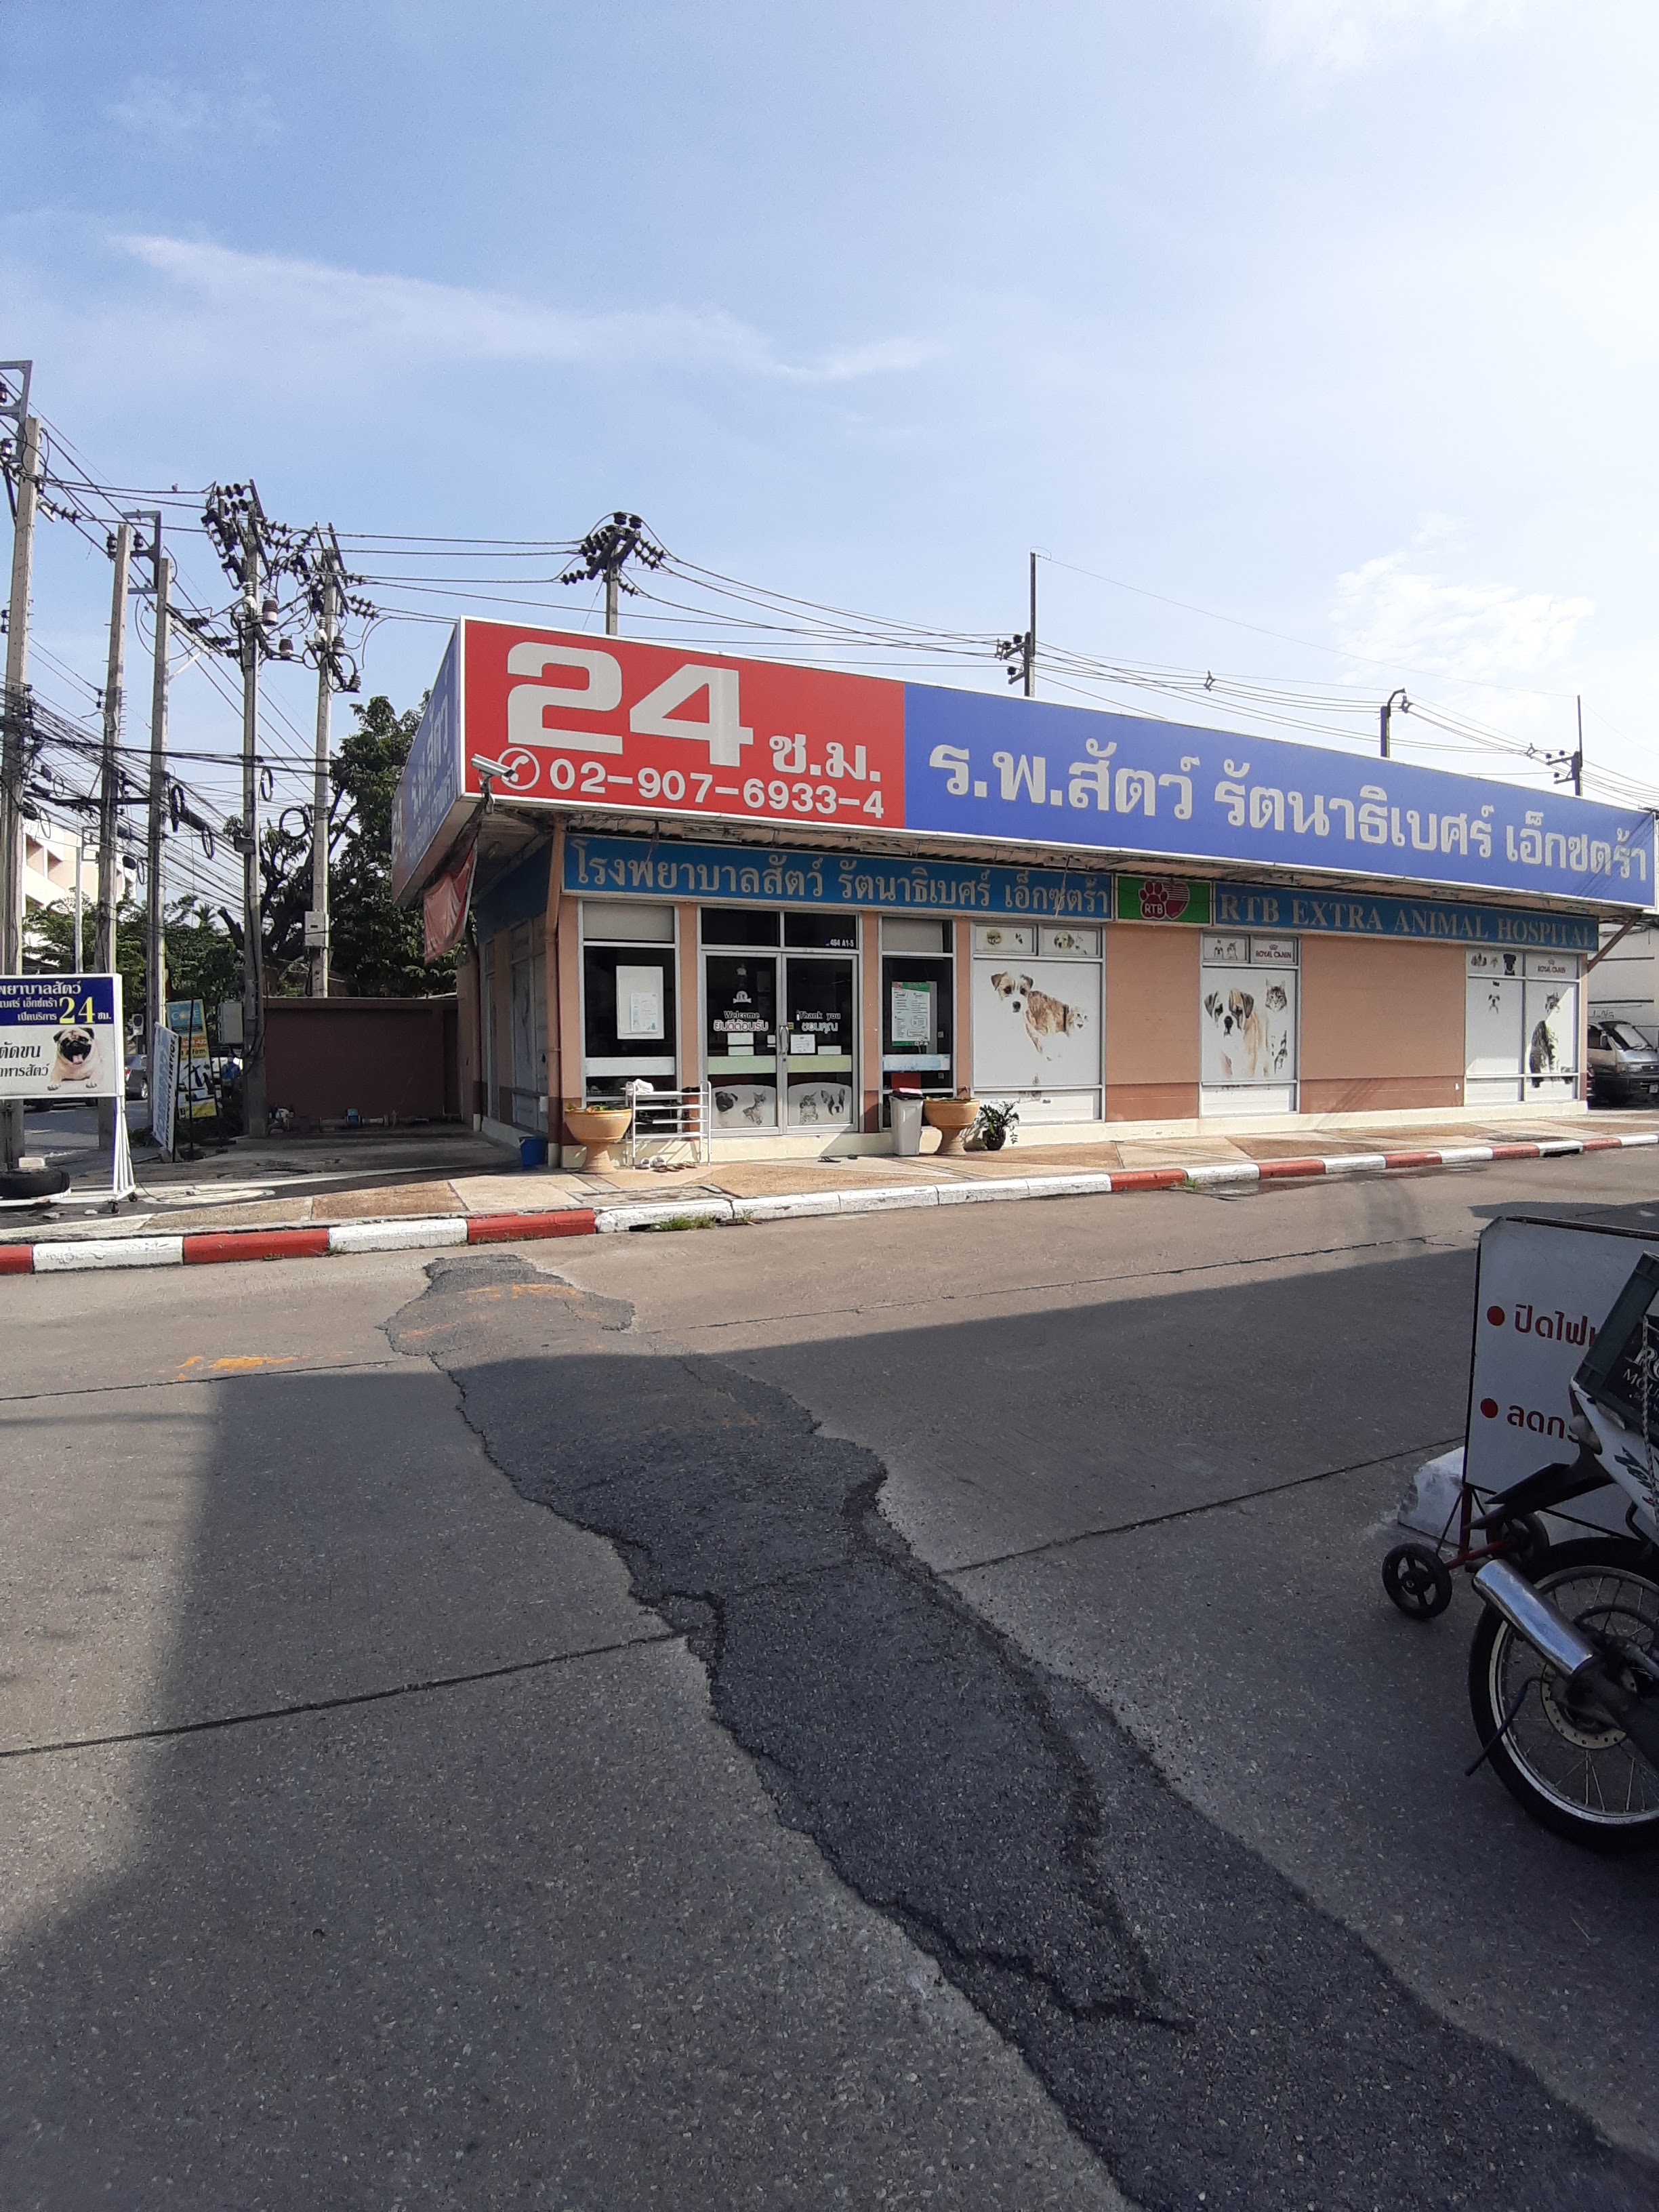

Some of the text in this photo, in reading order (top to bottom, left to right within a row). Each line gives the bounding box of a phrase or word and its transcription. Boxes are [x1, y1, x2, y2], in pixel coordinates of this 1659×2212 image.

[507, 641, 881, 782] 24 ช.ม.
[550, 758, 884, 819] 02-907-6933-4
[929, 738, 1200, 820] ร.พ.สัตว์
[1214, 758, 1495, 858] รัตนาธิเบศร์
[571, 839, 823, 897] โรงพยาบาลสัตว์
[839, 859, 991, 907] รัตนาธิเบศร์
[1145, 903, 1163, 914] RTB
[1221, 893, 1595, 947] RTB EXTRA ANIMAL HOSPITAL
[59, 996, 95, 1024] 24
[723, 1010, 760, 1019] Welcome
[826, 1012, 842, 1021] you
[714, 1019, 769, 1031] ยินดีต้อนรับ
[802, 1022, 838, 1035] ขอบคุณ
